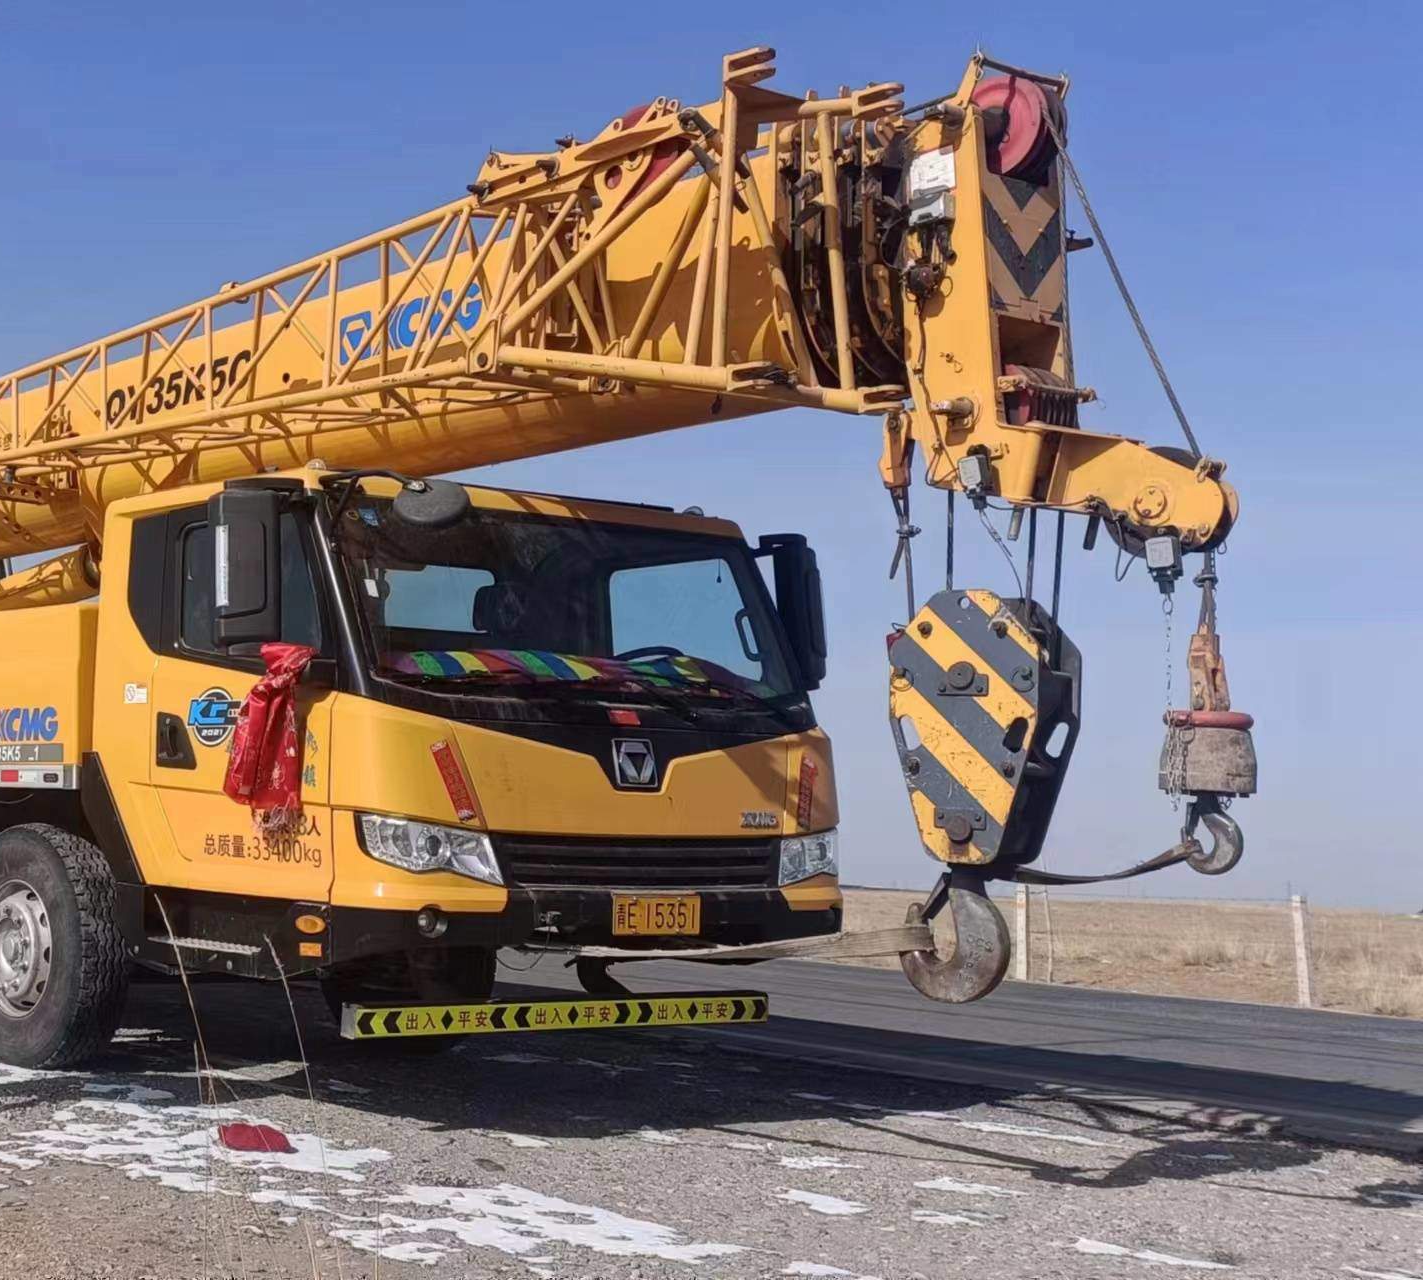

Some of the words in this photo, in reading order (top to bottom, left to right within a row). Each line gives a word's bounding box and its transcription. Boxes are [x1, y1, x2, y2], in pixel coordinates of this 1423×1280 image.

[458, 1009, 487, 1028] 平安
[583, 1004, 610, 1023] 平安
[702, 1002, 727, 1019] 平安
